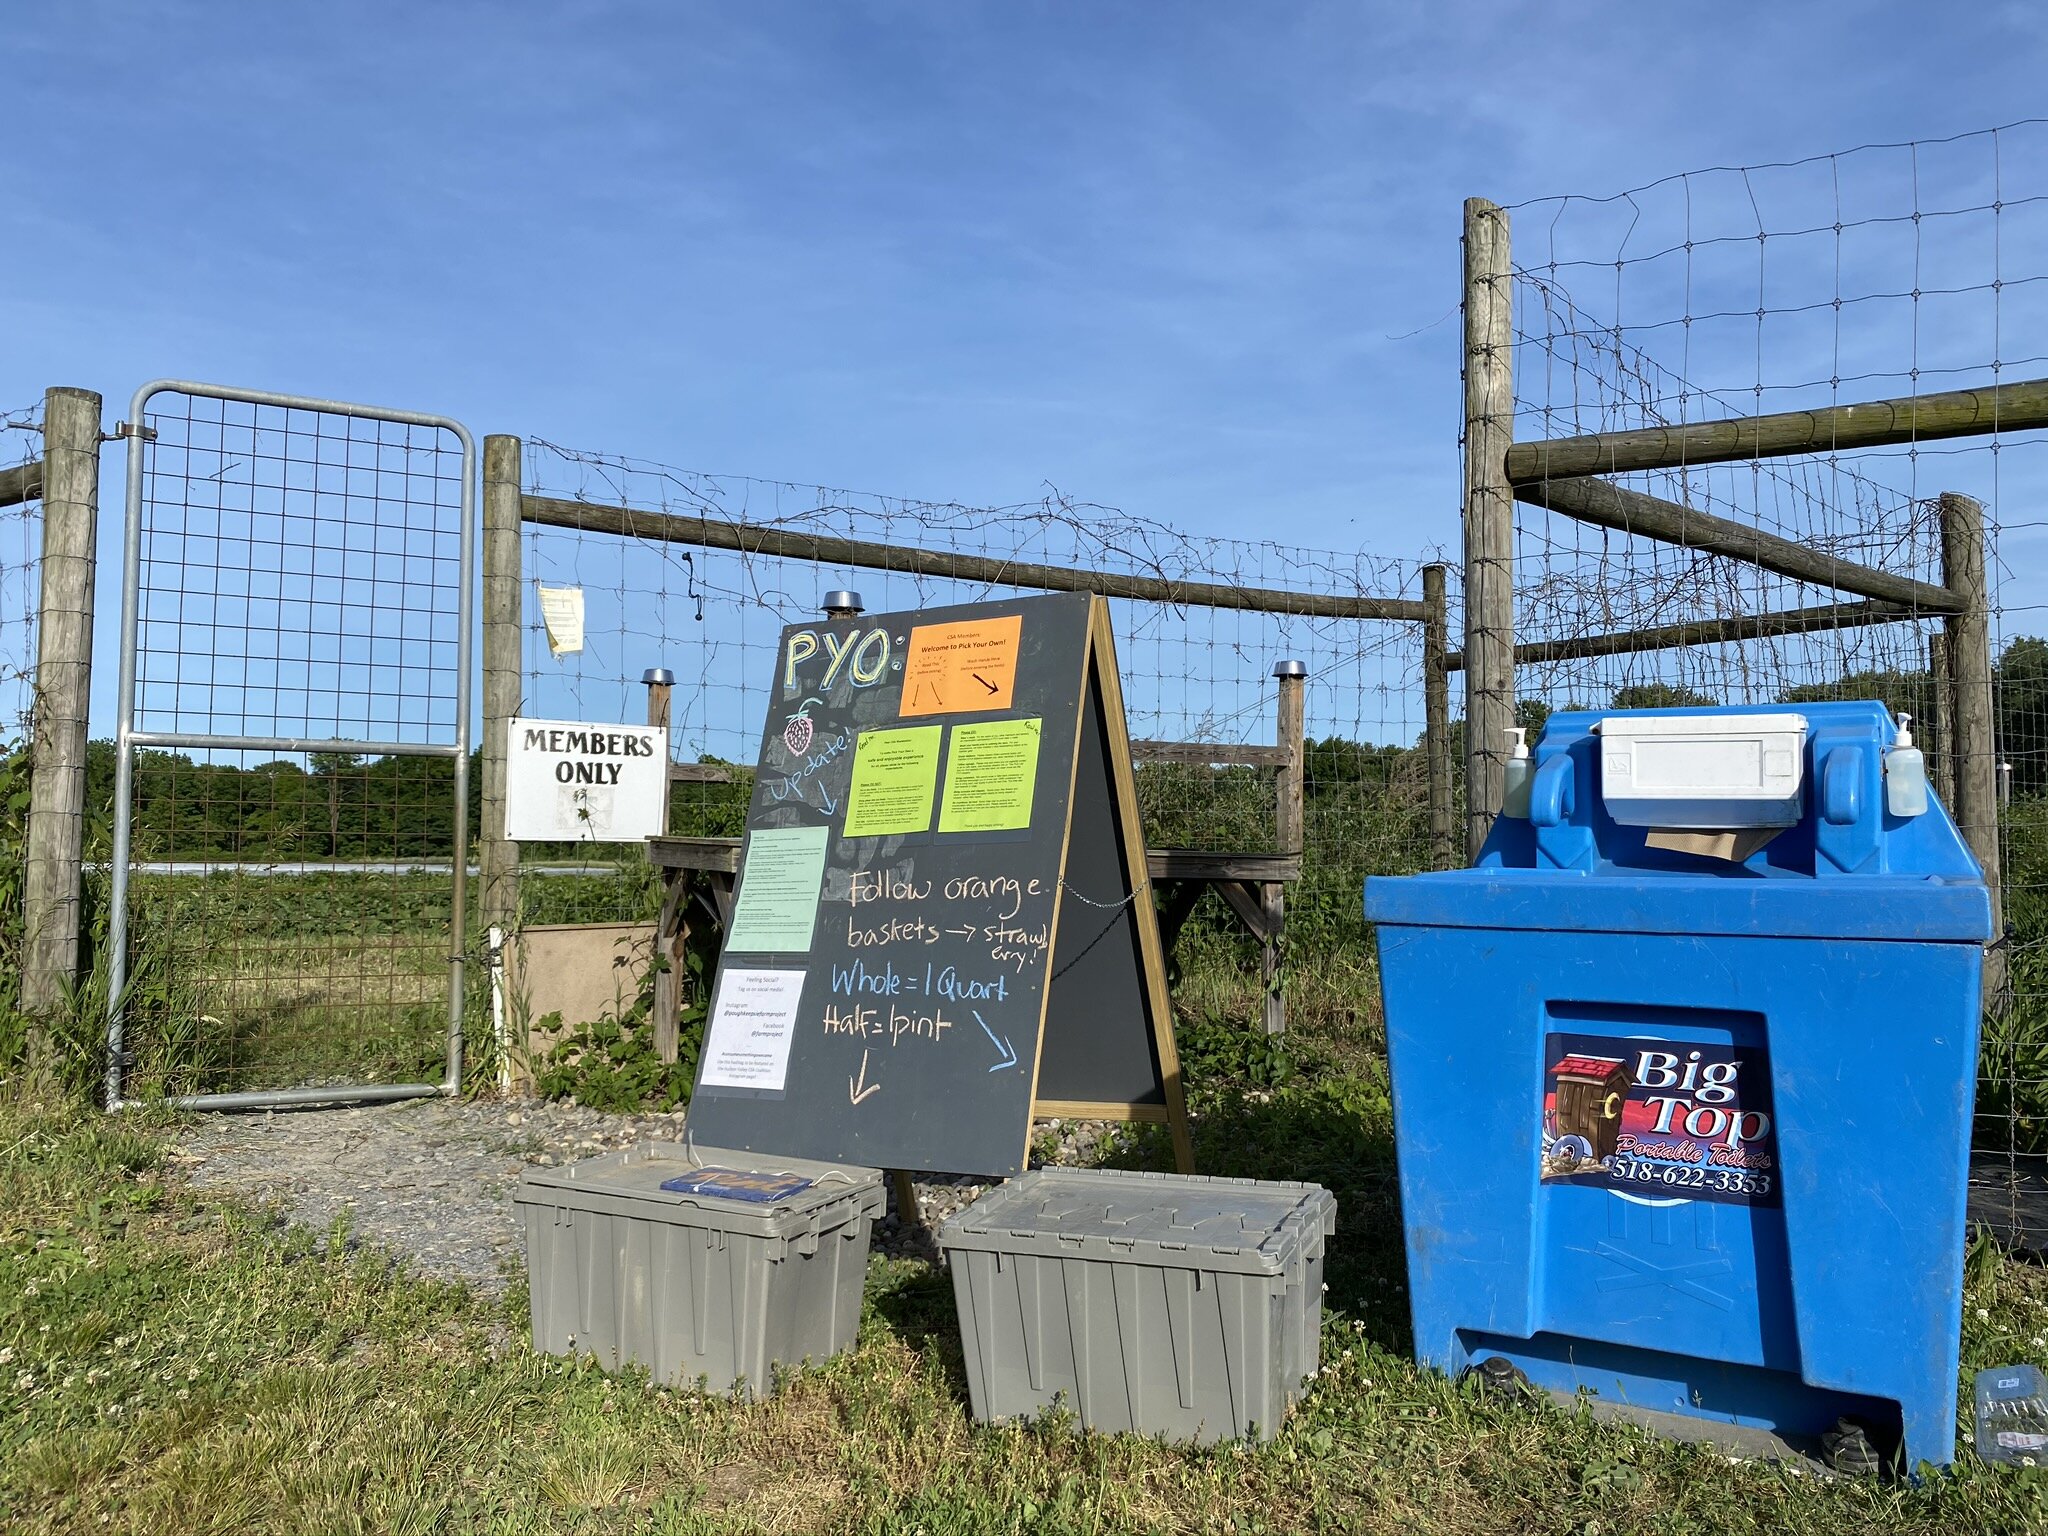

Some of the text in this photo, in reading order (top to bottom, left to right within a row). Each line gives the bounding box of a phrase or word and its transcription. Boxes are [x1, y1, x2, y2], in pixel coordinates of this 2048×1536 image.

[921, 639, 1006, 653] Welcome to Pick Your Own!
[523, 729, 654, 758] MEMBERS
[556, 761, 623, 785] ONLY
[850, 869, 1041, 920] Follow orange
[847, 916, 940, 947] baskets
[937, 966, 1009, 1002] Quart
[1631, 1051, 1743, 1103] Big
[1645, 1096, 1771, 1149] Top
[1615, 1134, 1772, 1169] Portable Toilets
[1611, 1159, 1771, 1194] 518-622-3353
